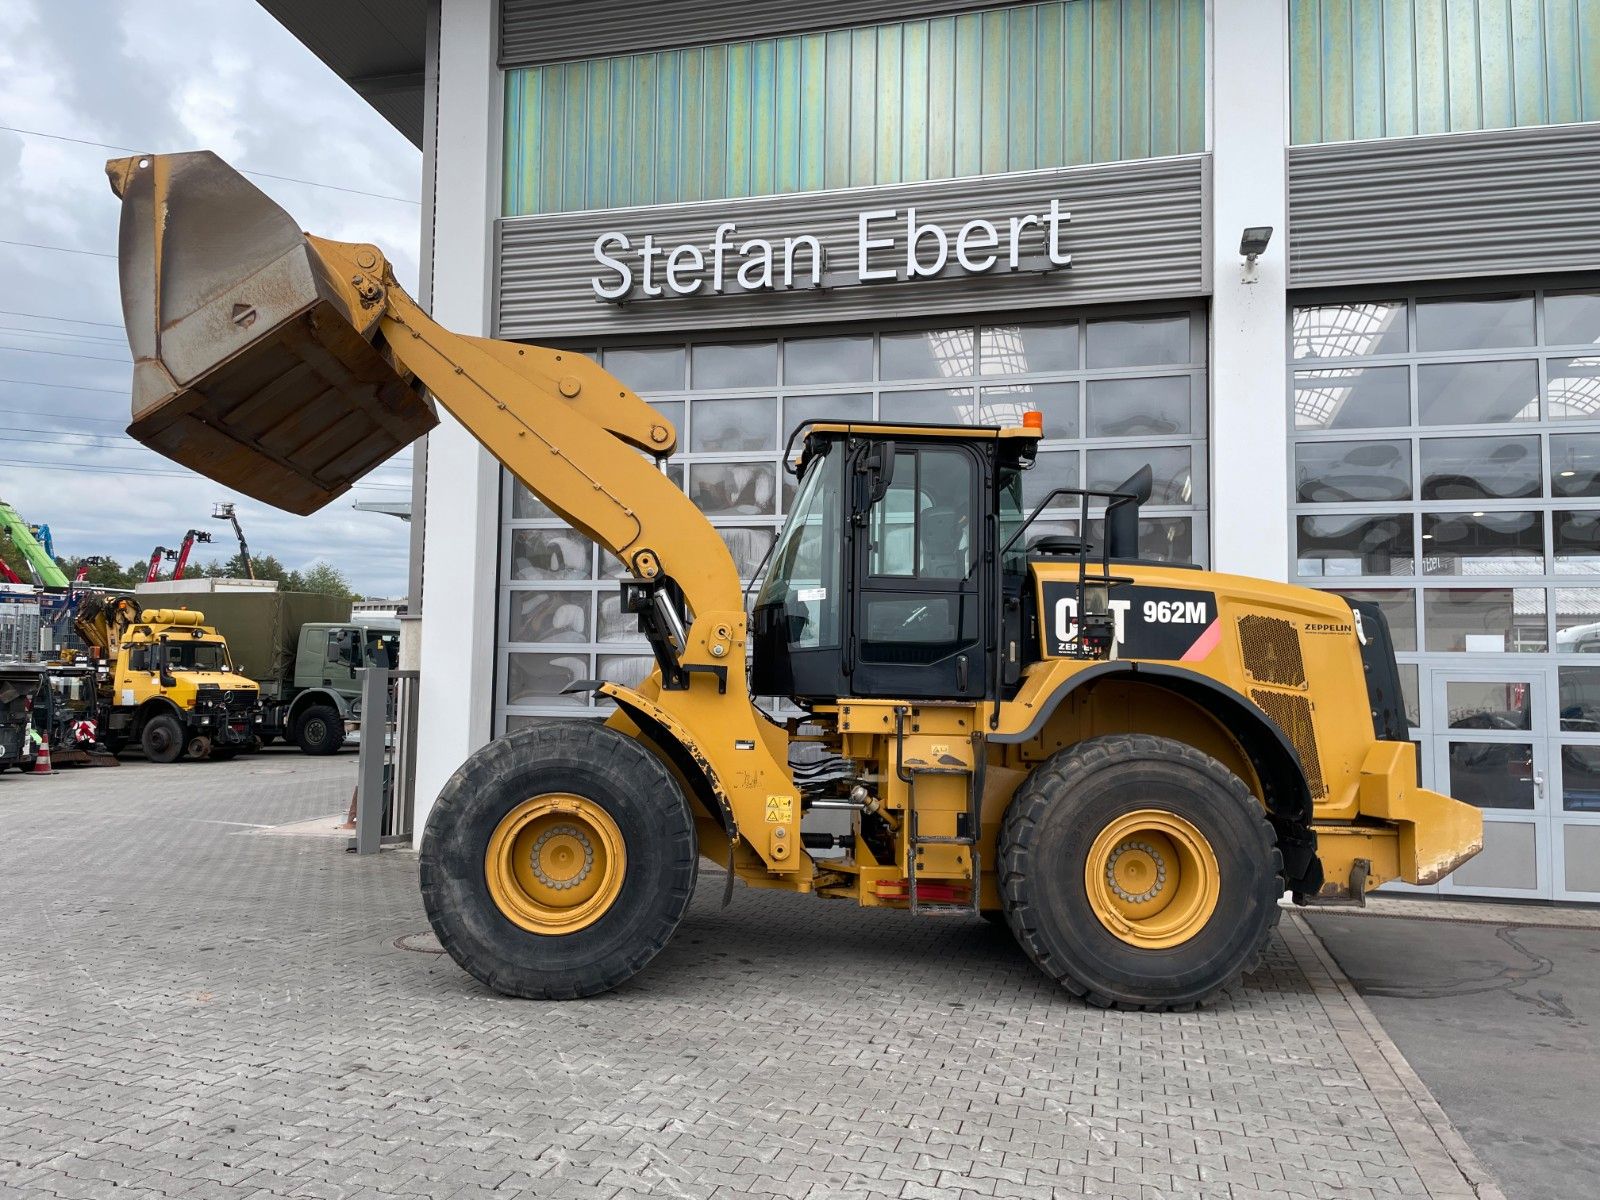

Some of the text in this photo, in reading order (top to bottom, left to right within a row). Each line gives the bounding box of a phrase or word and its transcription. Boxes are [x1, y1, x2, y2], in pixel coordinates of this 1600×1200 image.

[592, 199, 1072, 299] Stefan Ebert
[1055, 598, 1130, 644] CT
[1143, 600, 1206, 624] 962M
[1304, 623, 1352, 632] ZEPPELIN
